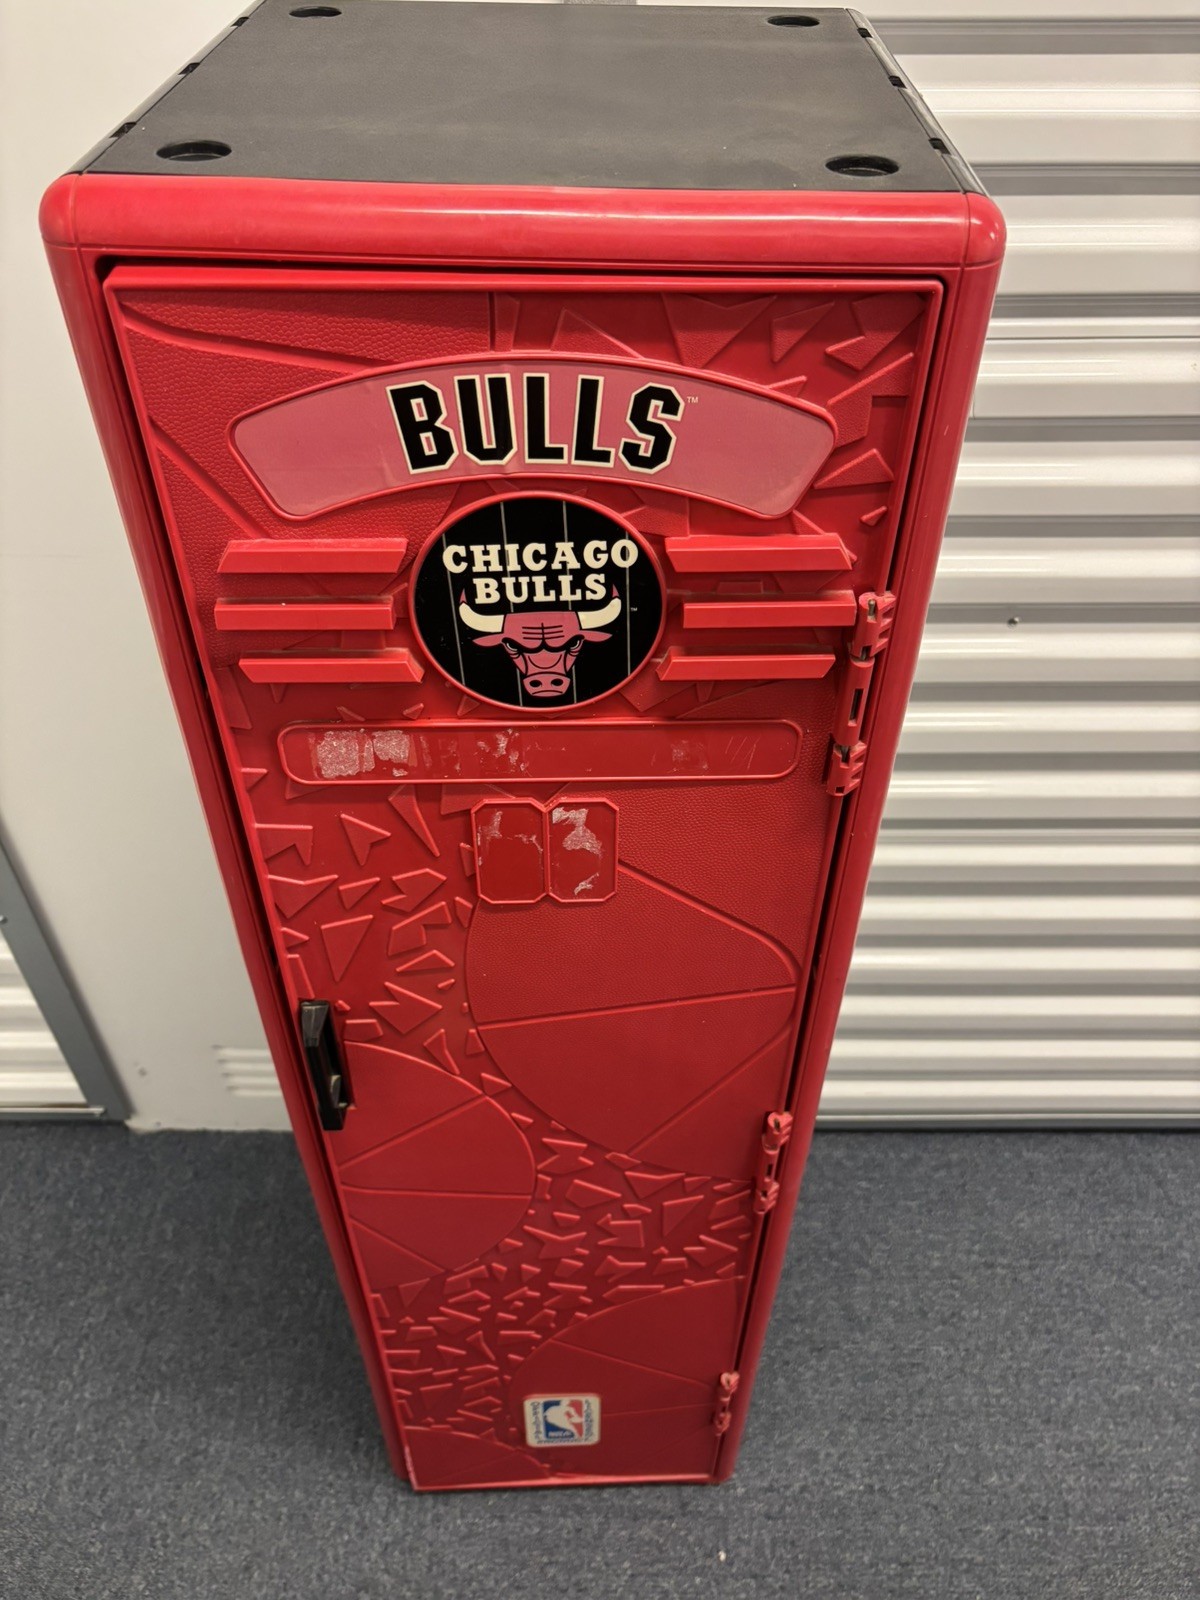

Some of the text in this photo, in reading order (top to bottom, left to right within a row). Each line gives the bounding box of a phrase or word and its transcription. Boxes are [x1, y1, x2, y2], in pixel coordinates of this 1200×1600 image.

[385, 372, 685, 475] BULLS
[442, 539, 639, 574] CHICAGO
[472, 573, 607, 604] BULLS
